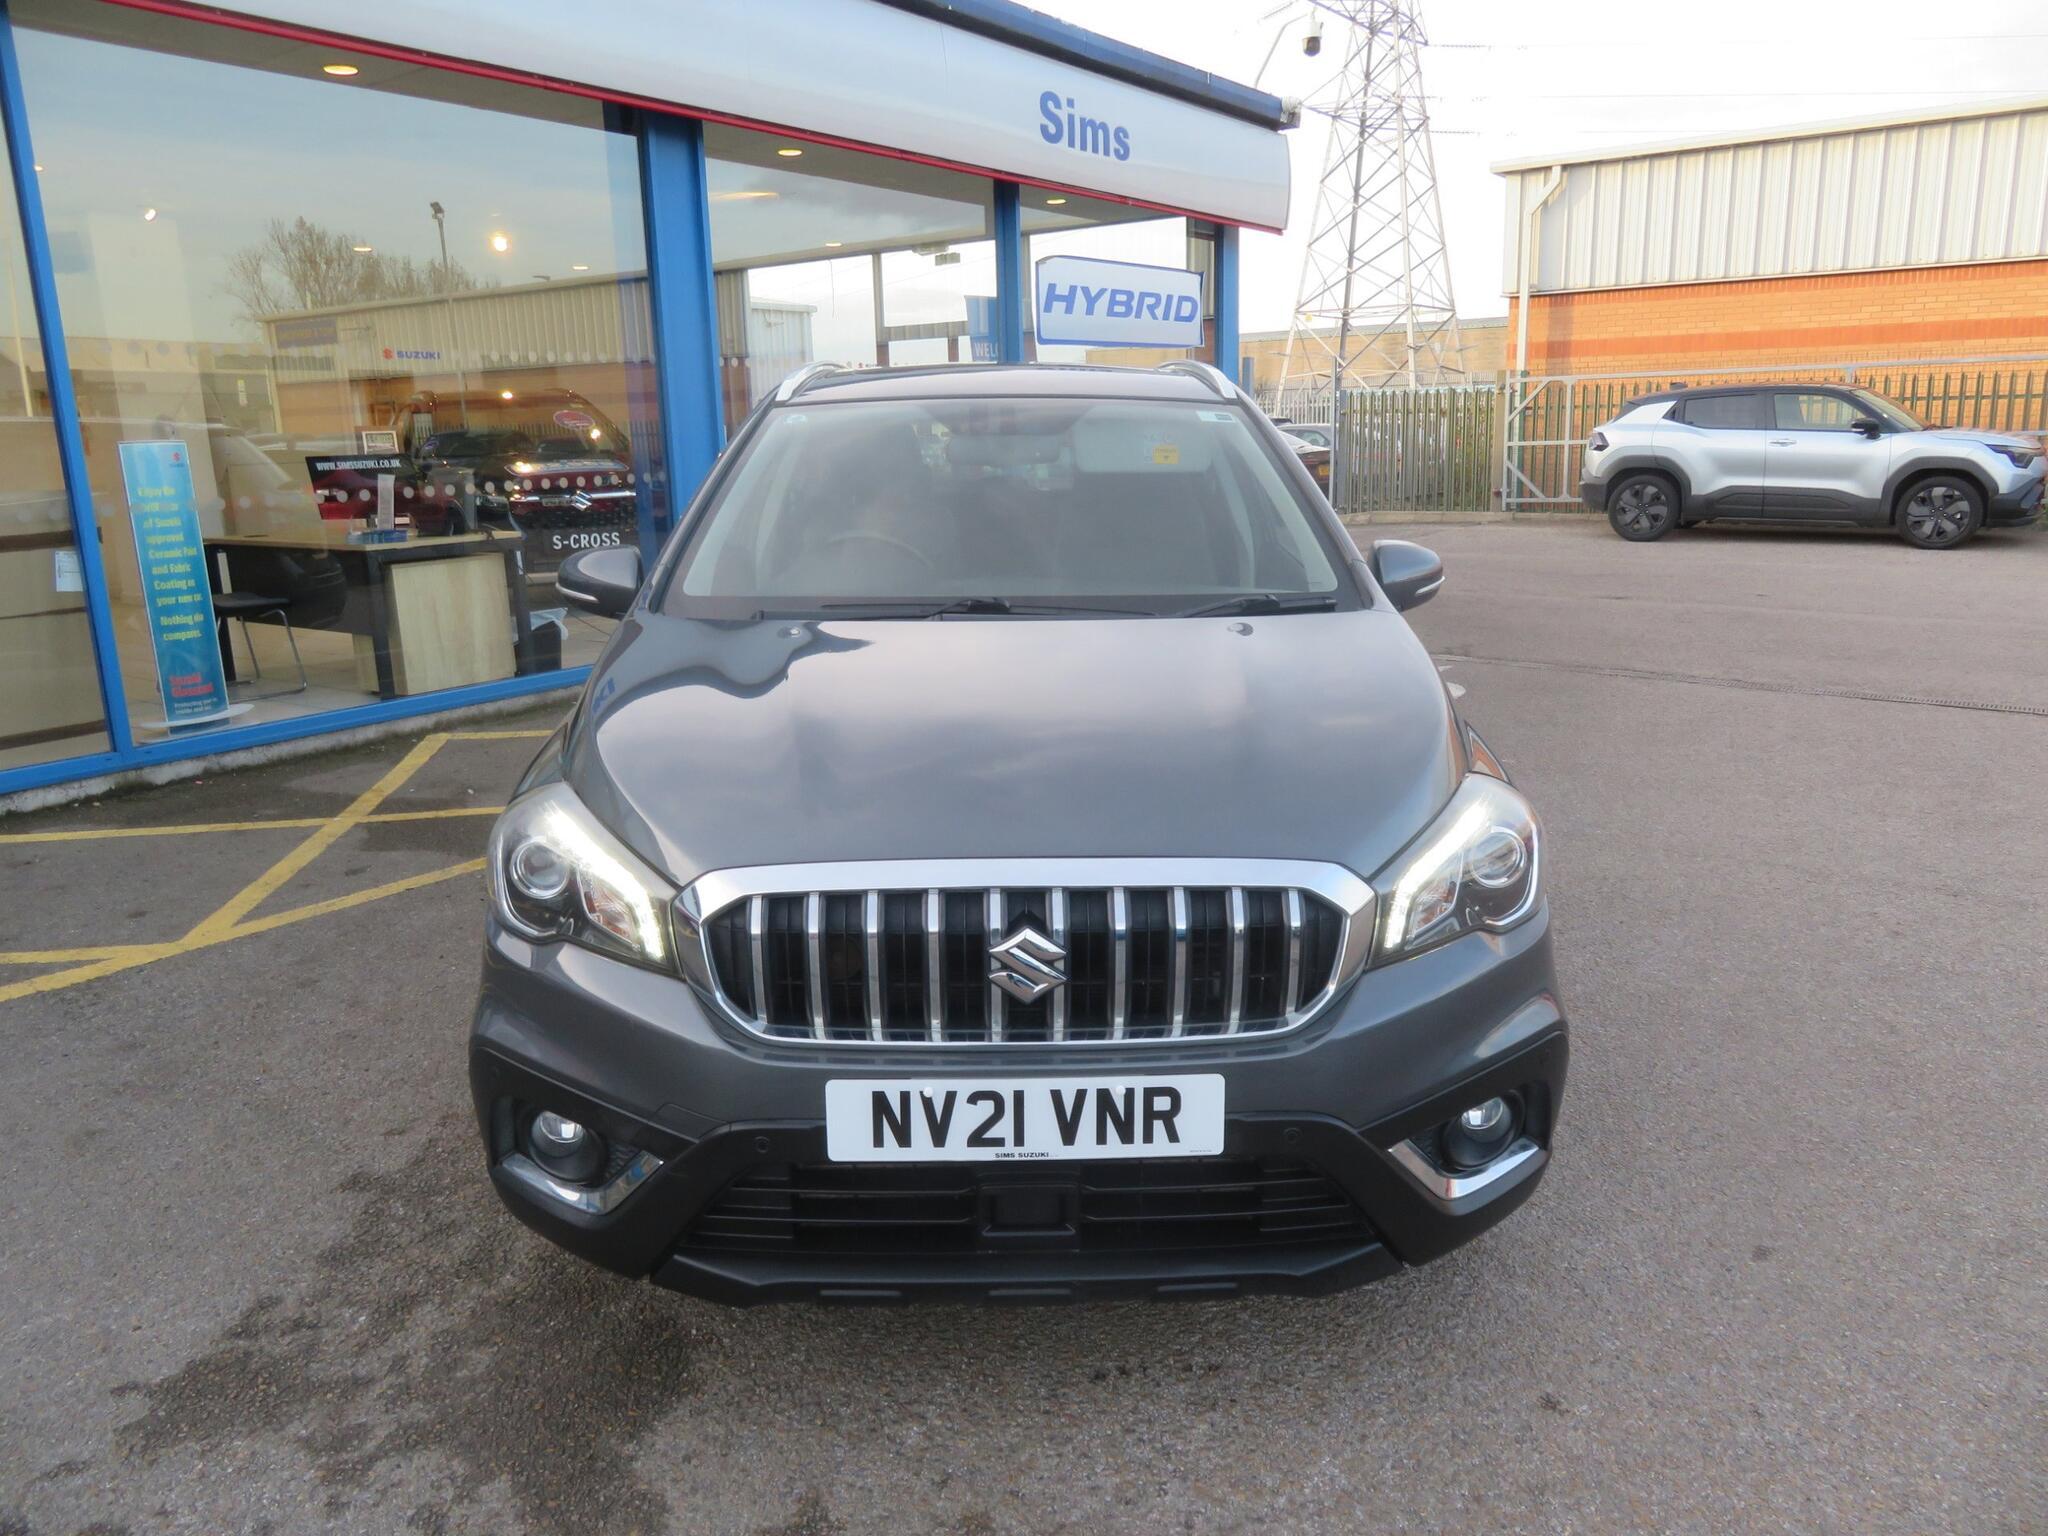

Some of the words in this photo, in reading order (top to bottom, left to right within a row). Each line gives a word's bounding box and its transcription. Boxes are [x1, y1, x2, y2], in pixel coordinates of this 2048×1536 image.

[1040, 90, 1130, 161] Sims
[1043, 283, 1199, 323] HYBRID
[397, 350, 441, 361] SUZUKI
[552, 531, 621, 550] S-CROSS
[871, 1089, 1025, 1149] NV21
[1049, 1086, 1183, 1147] VNR
